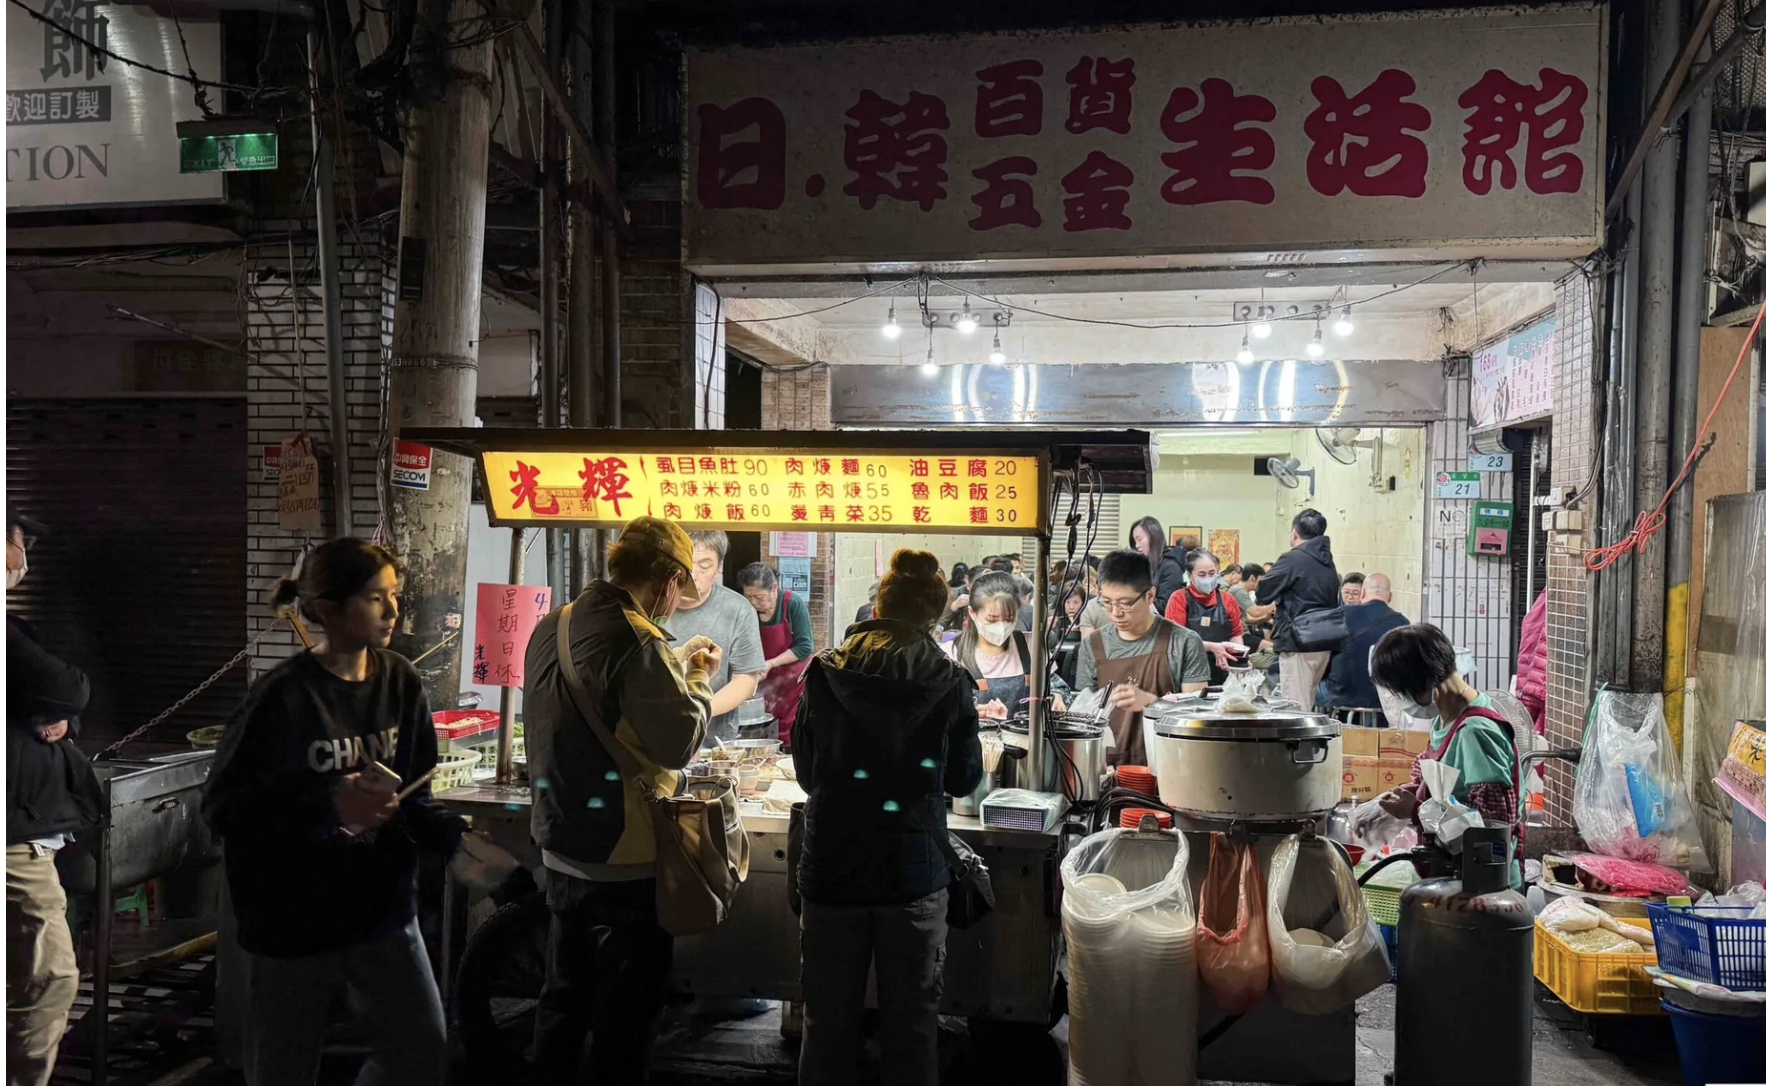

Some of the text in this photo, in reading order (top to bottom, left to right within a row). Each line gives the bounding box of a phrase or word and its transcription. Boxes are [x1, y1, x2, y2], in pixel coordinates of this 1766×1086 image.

[974, 55, 1136, 138] 百貨
[1159, 67, 1589, 205] 生活館
[968, 150, 1135, 232] 五金
[656, 457, 769, 476] 虱目魚肚 90
[866, 464, 887, 478] 60
[909, 458, 1017, 478] 油豆腐 20
[1487, 456, 1504, 468] 23
[393, 469, 426, 482] SECOM
[509, 457, 633, 518] 光輝
[749, 483, 769, 498] 60
[867, 482, 890, 499] 55
[911, 482, 1018, 501] 魯肉飯 25
[1455, 484, 1471, 495] 21
[750, 504, 771, 517] 60
[868, 505, 893, 522] 35
[912, 506, 1017, 524] 乾麵 30
[494, 588, 521, 684] 星期日休
[472, 644, 489, 685] 光輝
